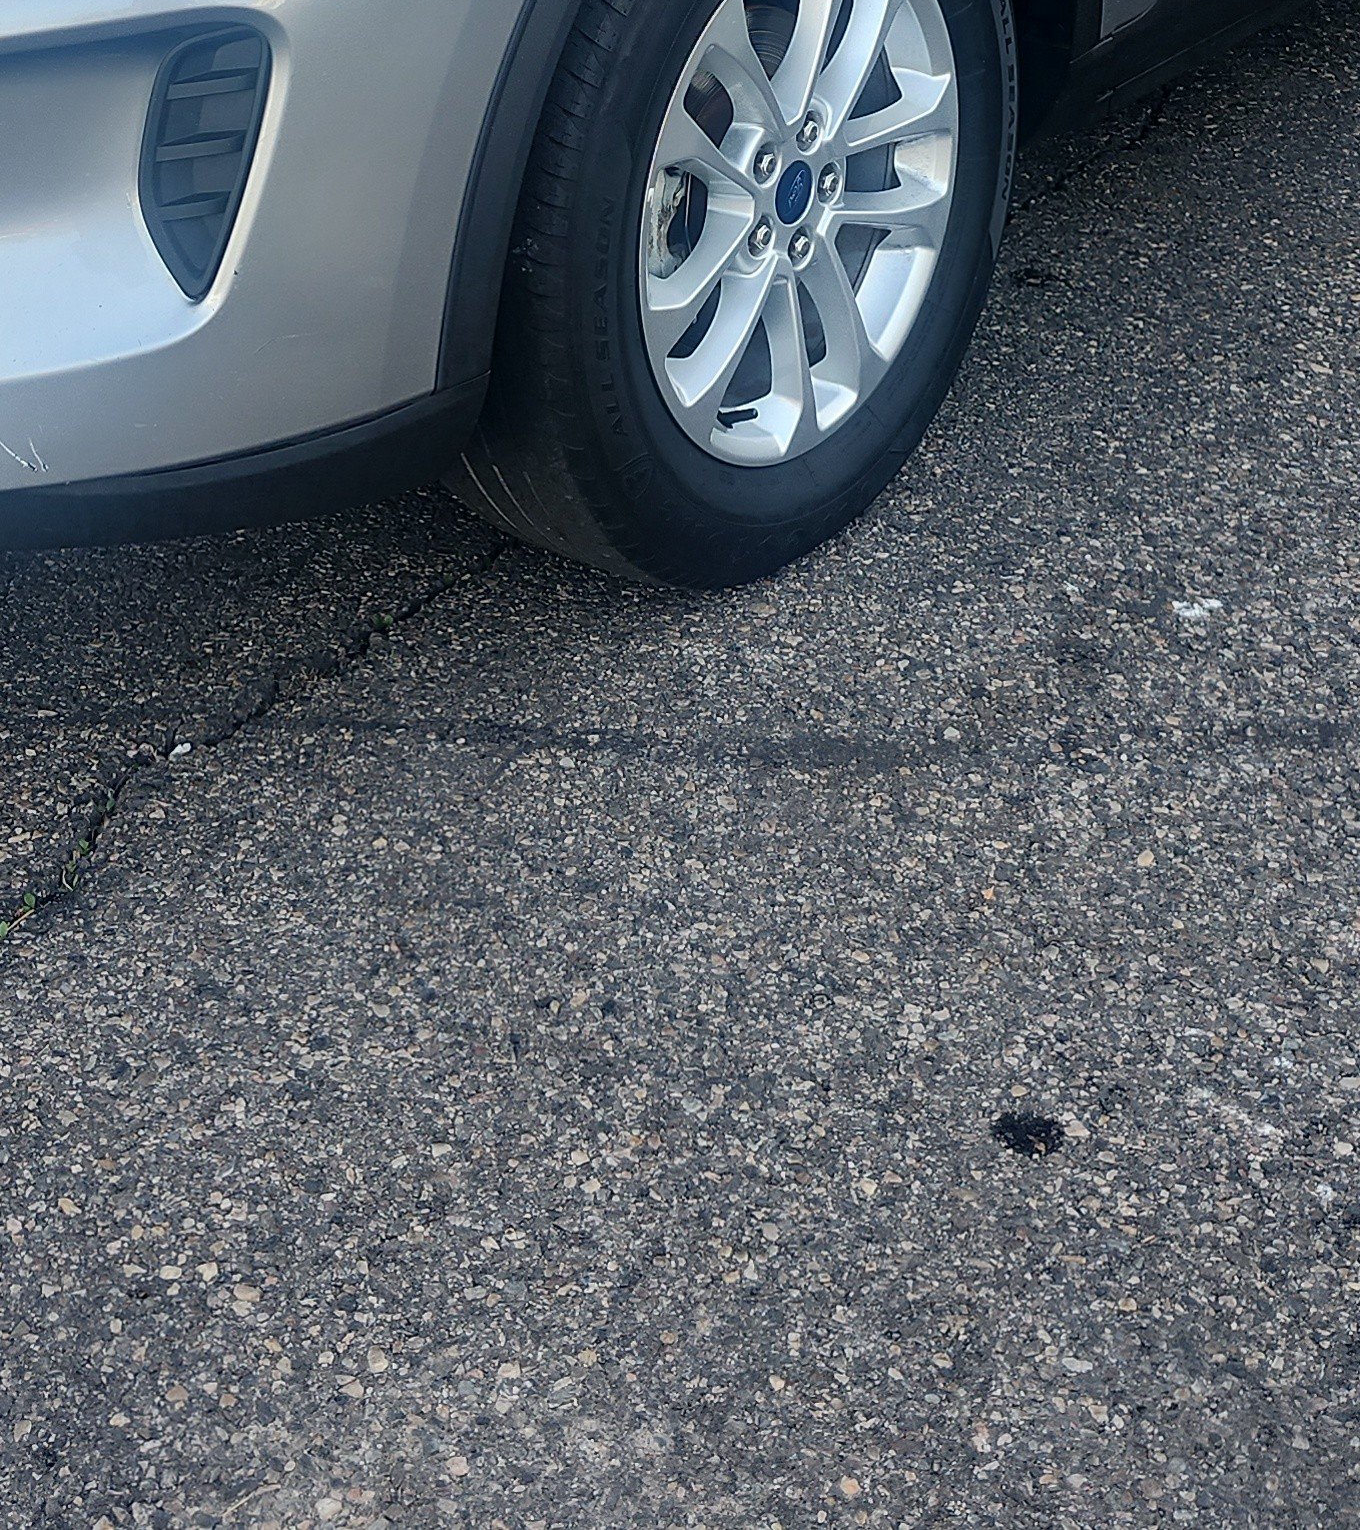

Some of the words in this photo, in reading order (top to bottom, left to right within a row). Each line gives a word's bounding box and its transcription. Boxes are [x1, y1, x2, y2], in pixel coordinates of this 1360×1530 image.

[1000, 63, 1016, 202] SEASON
[592, 195, 616, 362] SEASON
[600, 373, 629, 438] ALL
